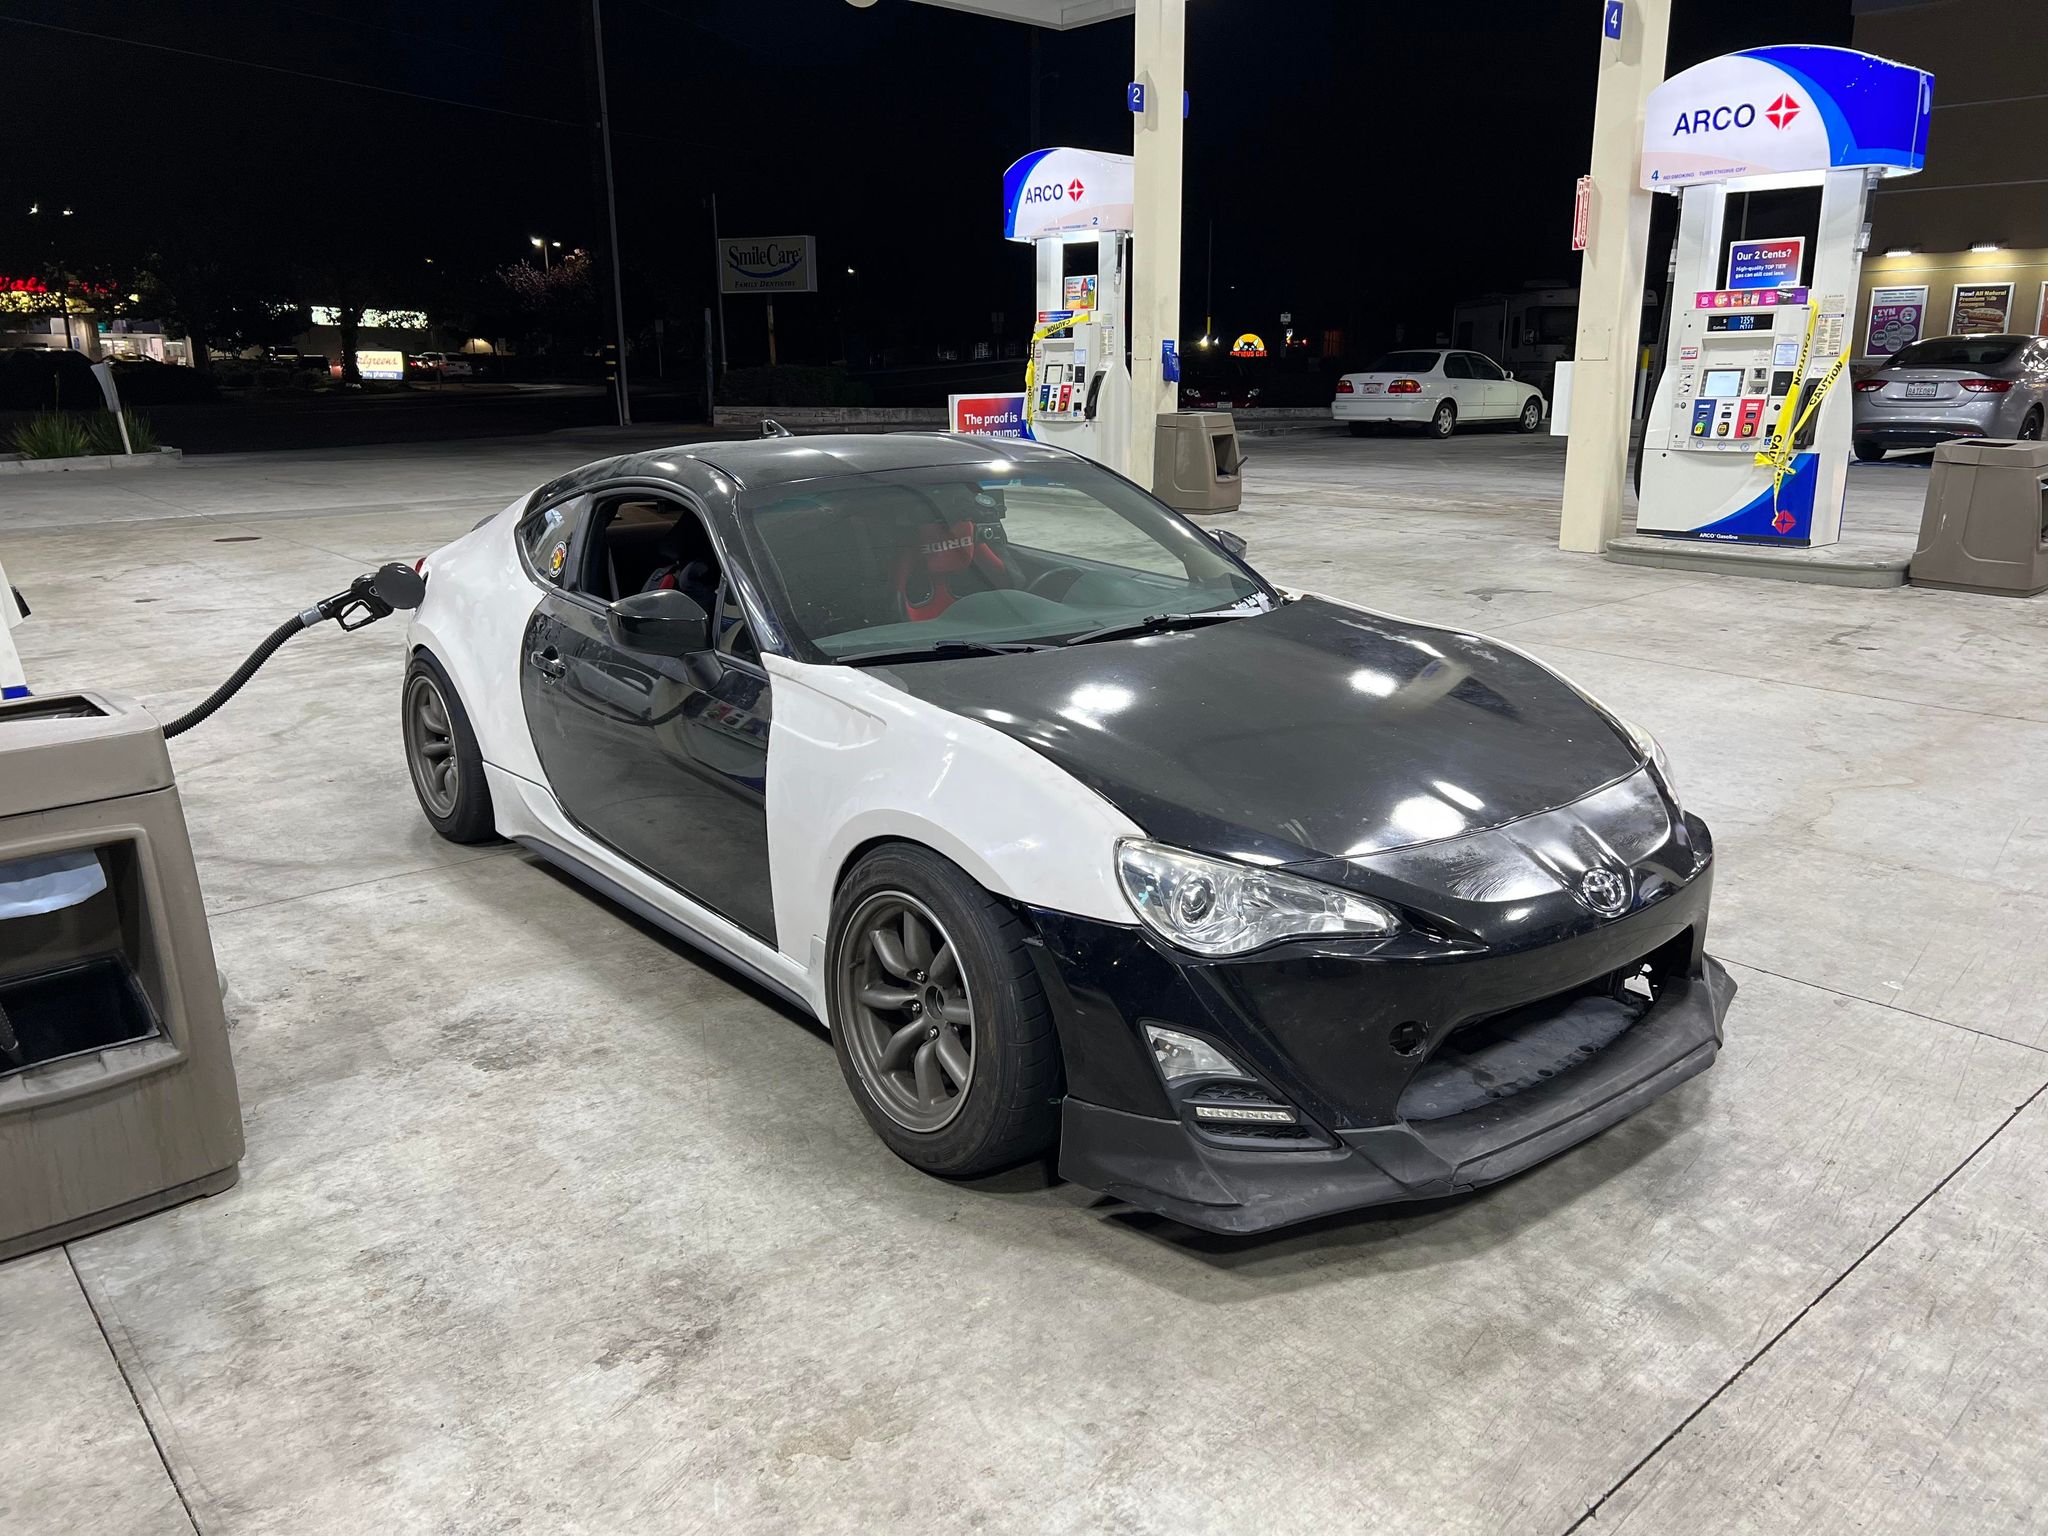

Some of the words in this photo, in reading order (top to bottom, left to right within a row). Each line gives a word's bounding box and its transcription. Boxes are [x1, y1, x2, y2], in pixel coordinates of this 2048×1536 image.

[1610, 8, 1618, 29] 4
[1132, 87, 1141, 103] 2
[1672, 103, 1756, 136] ARCO
[1651, 169, 1659, 181] 4
[1025, 183, 1064, 204] ARCO
[1092, 216, 1098, 225] 2
[1736, 251, 1753, 261] Our
[1754, 250, 1760, 260] 2
[1761, 248, 1792, 259] Cents?
[1877, 307, 1896, 317] ZYN
[1047, 319, 1071, 333] CAUTION
[1793, 332, 1811, 386] CAUTION
[1809, 361, 1843, 406] CAUTION
[963, 413, 982, 425] The
[984, 412, 1008, 426] proof
[1009, 411, 1018, 423] is
[920, 536, 973, 553] BRIDE
